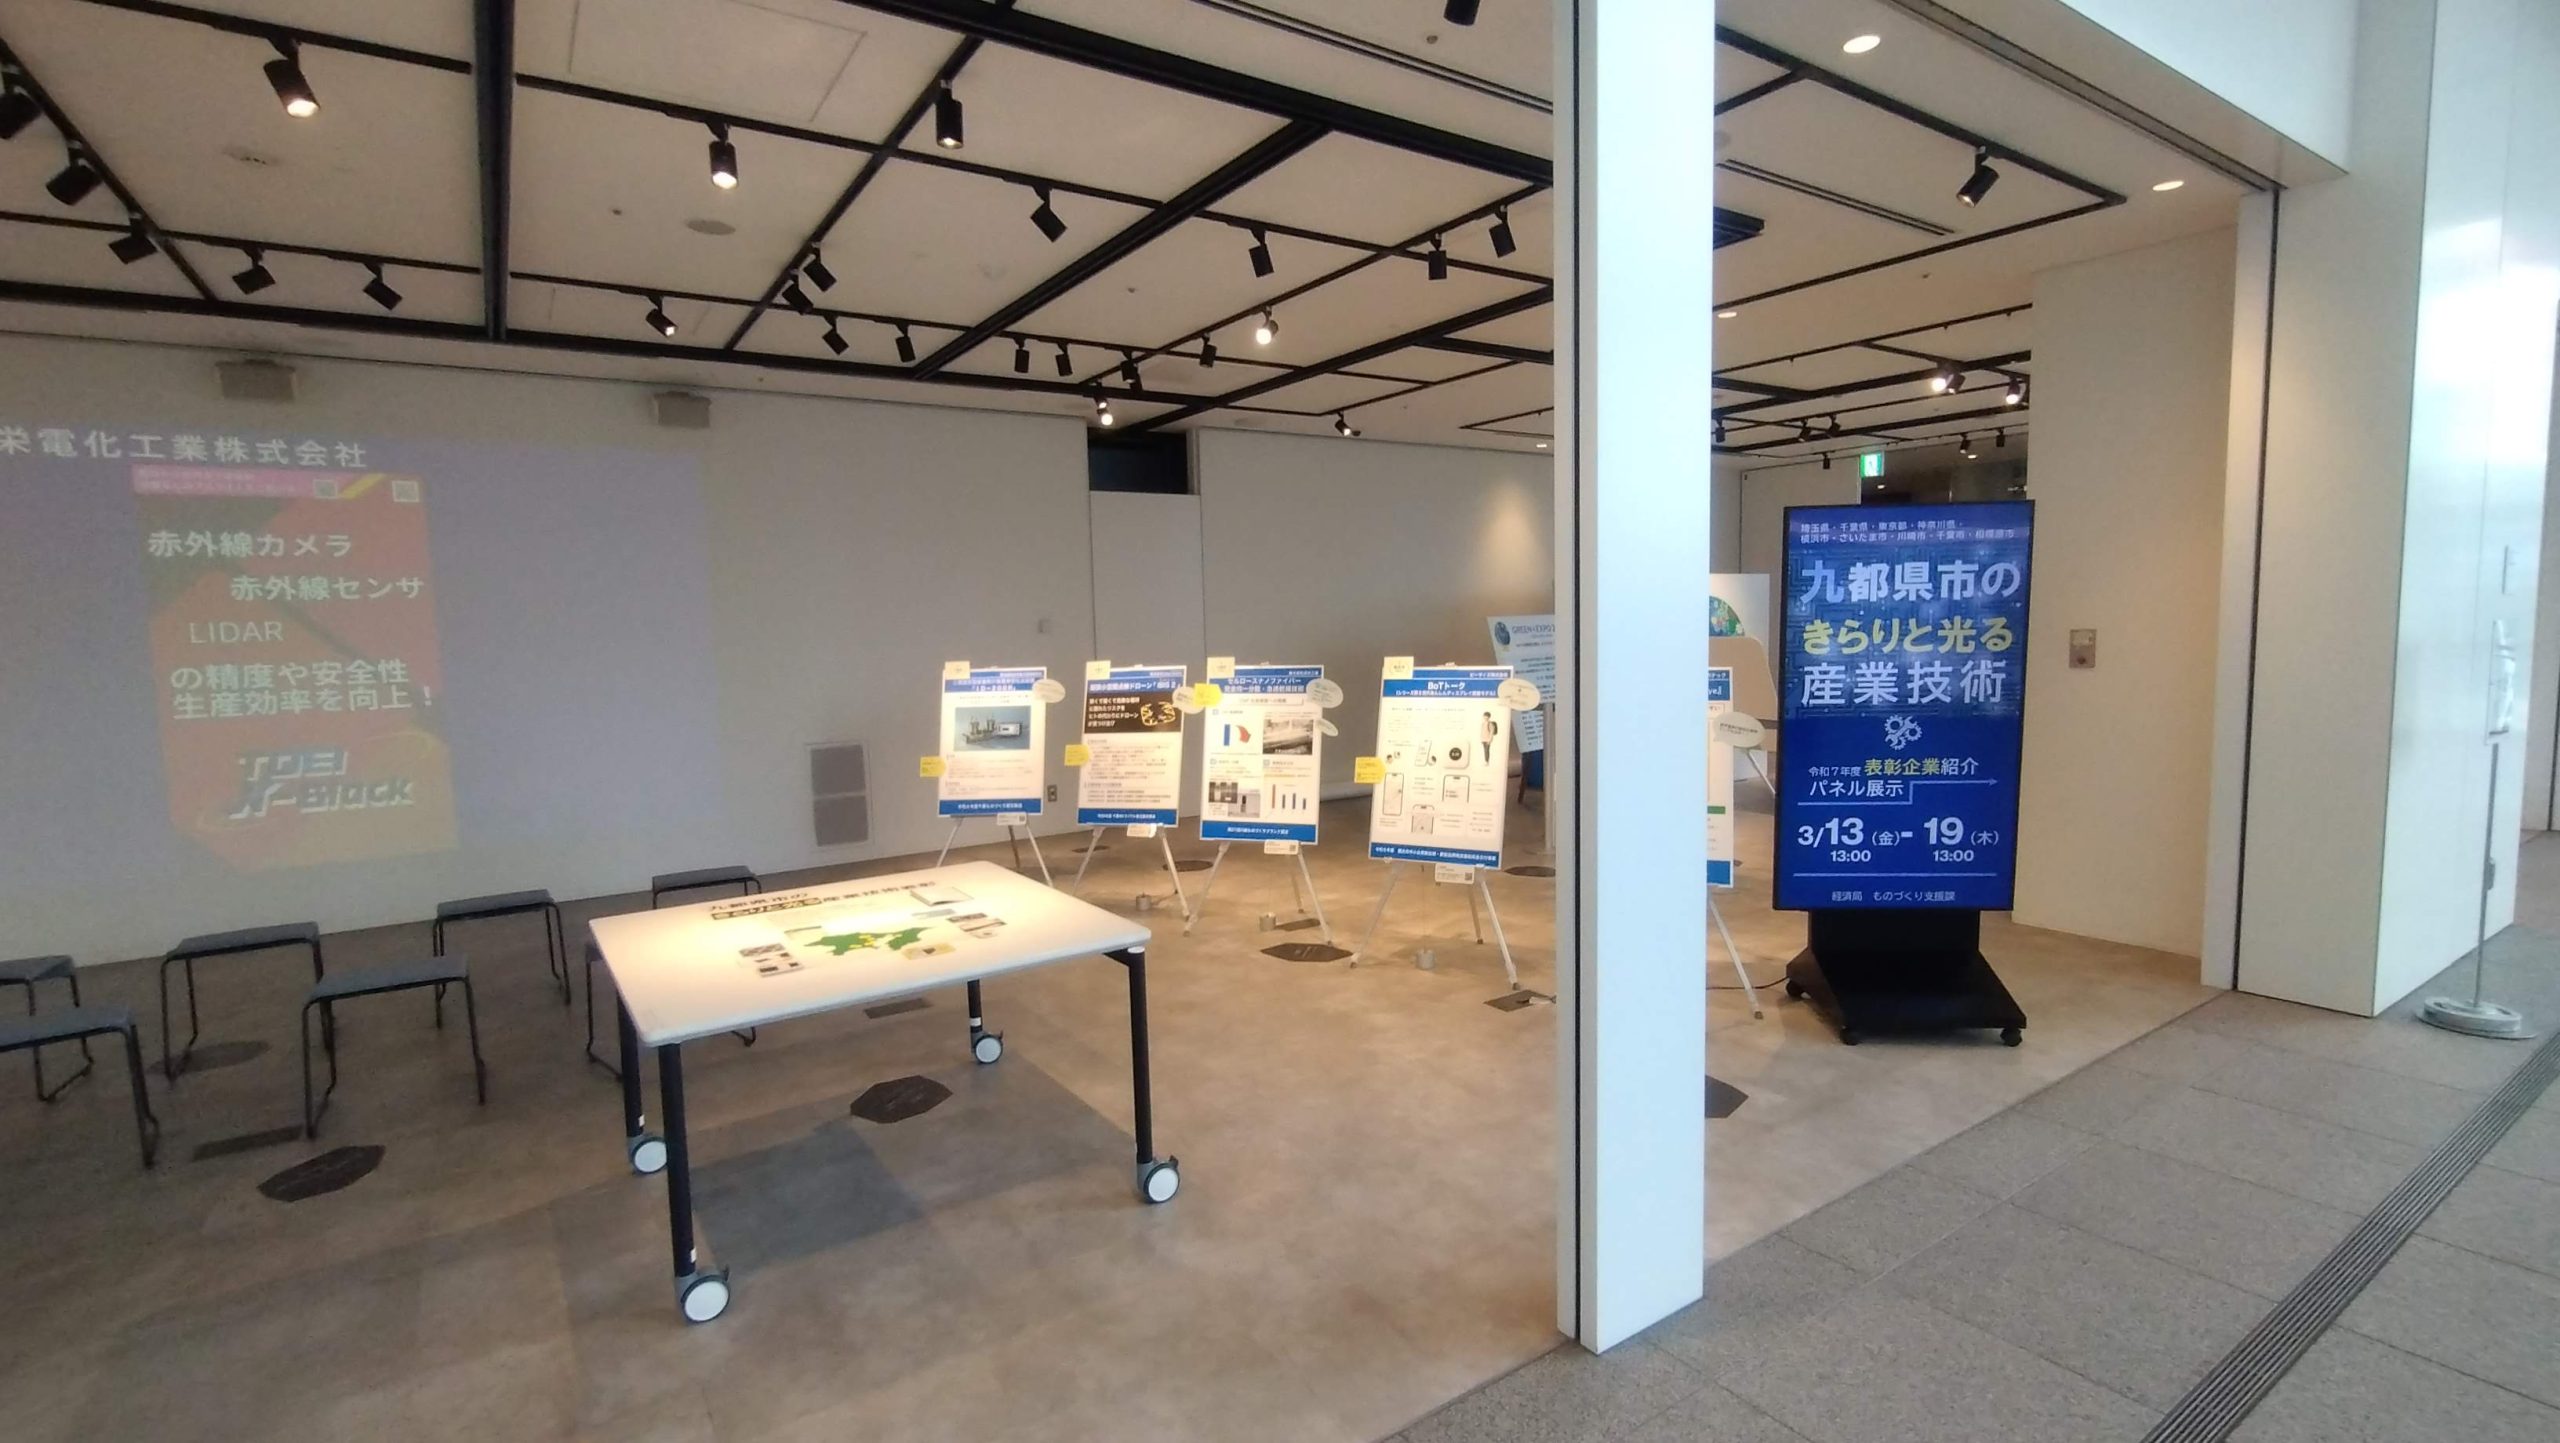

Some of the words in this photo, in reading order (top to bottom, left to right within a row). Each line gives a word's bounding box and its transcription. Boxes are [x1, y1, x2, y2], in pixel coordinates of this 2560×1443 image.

[148, 530, 352, 558] 赤外線カメラ
[230, 575, 424, 601] 赤外線センサ
[1801, 560, 2021, 603] 九都県市の
[189, 621, 283, 643] LIDAR
[1803, 614, 2013, 654] きらりと光る
[171, 659, 409, 690] の精度や安全性
[1428, 681, 1465, 690] BoTトーク
[1801, 661, 2006, 706] 産業技術
[1864, 758, 1979, 776] 表彰企業紹介
[1810, 780, 1904, 797] パネル展示
[1798, 817, 1864, 846] 3/13
[1924, 817, 1964, 845] 19
[1830, 849, 1871, 863] 13:00
[1933, 849, 1974, 863] 13:00
